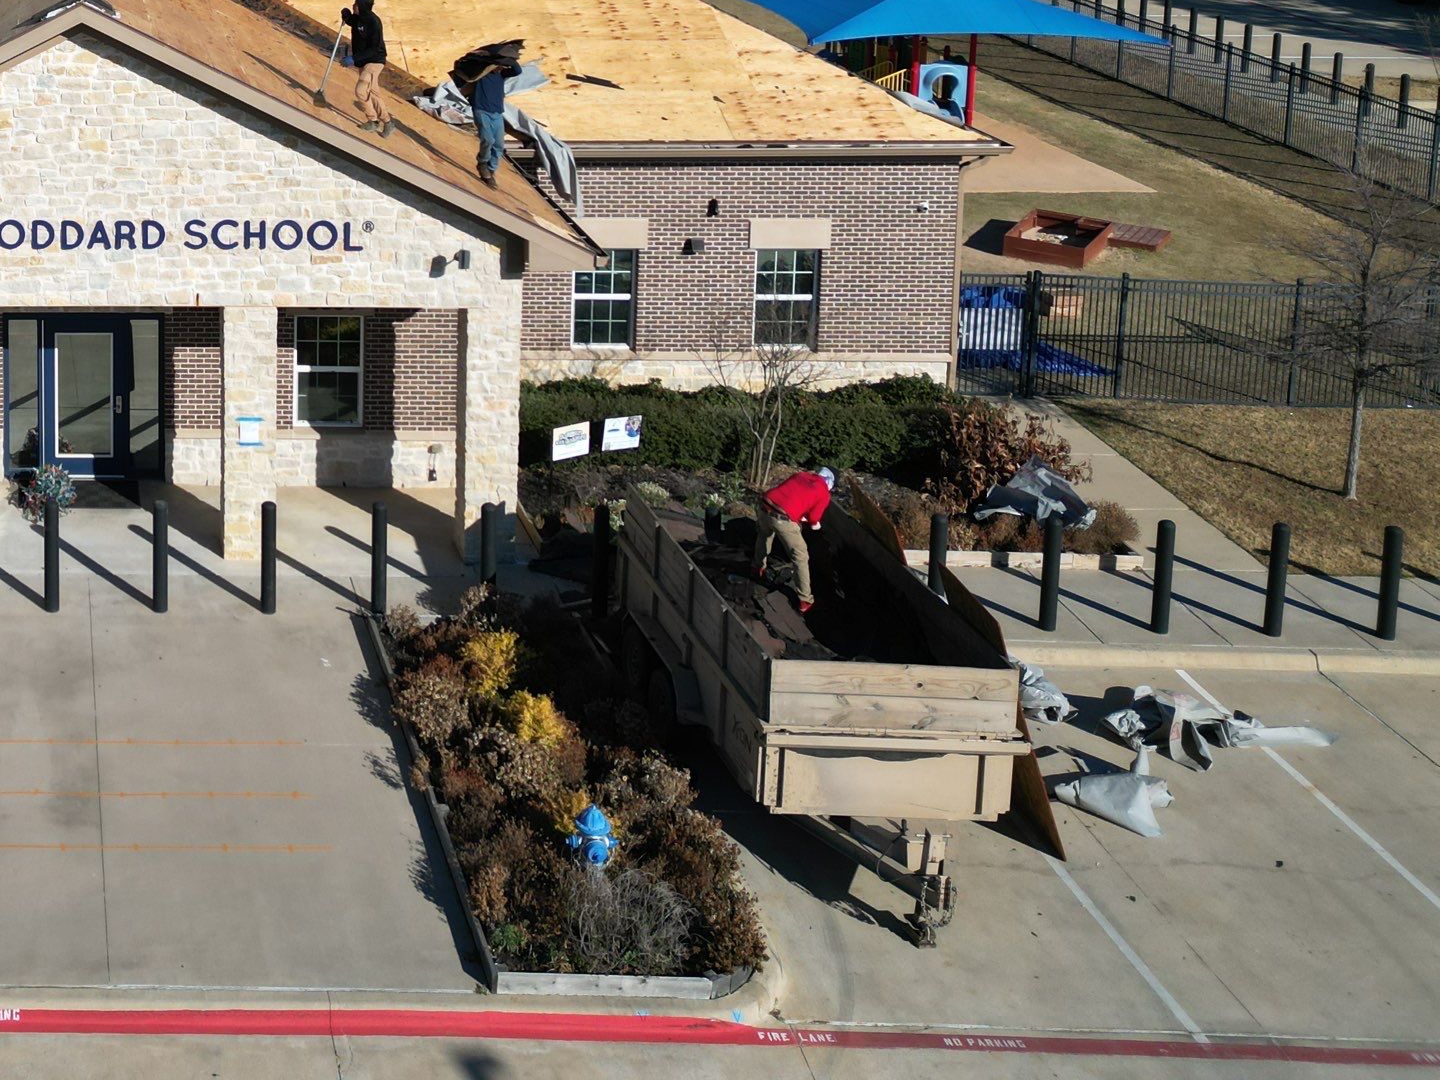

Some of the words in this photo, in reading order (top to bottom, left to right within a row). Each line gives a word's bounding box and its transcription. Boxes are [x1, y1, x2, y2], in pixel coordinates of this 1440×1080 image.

[757, 1031, 790, 1042] FIRE
[797, 1032, 836, 1043] LANE
[943, 1037, 963, 1048] NO
[966, 1037, 1027, 1049] PARKING
